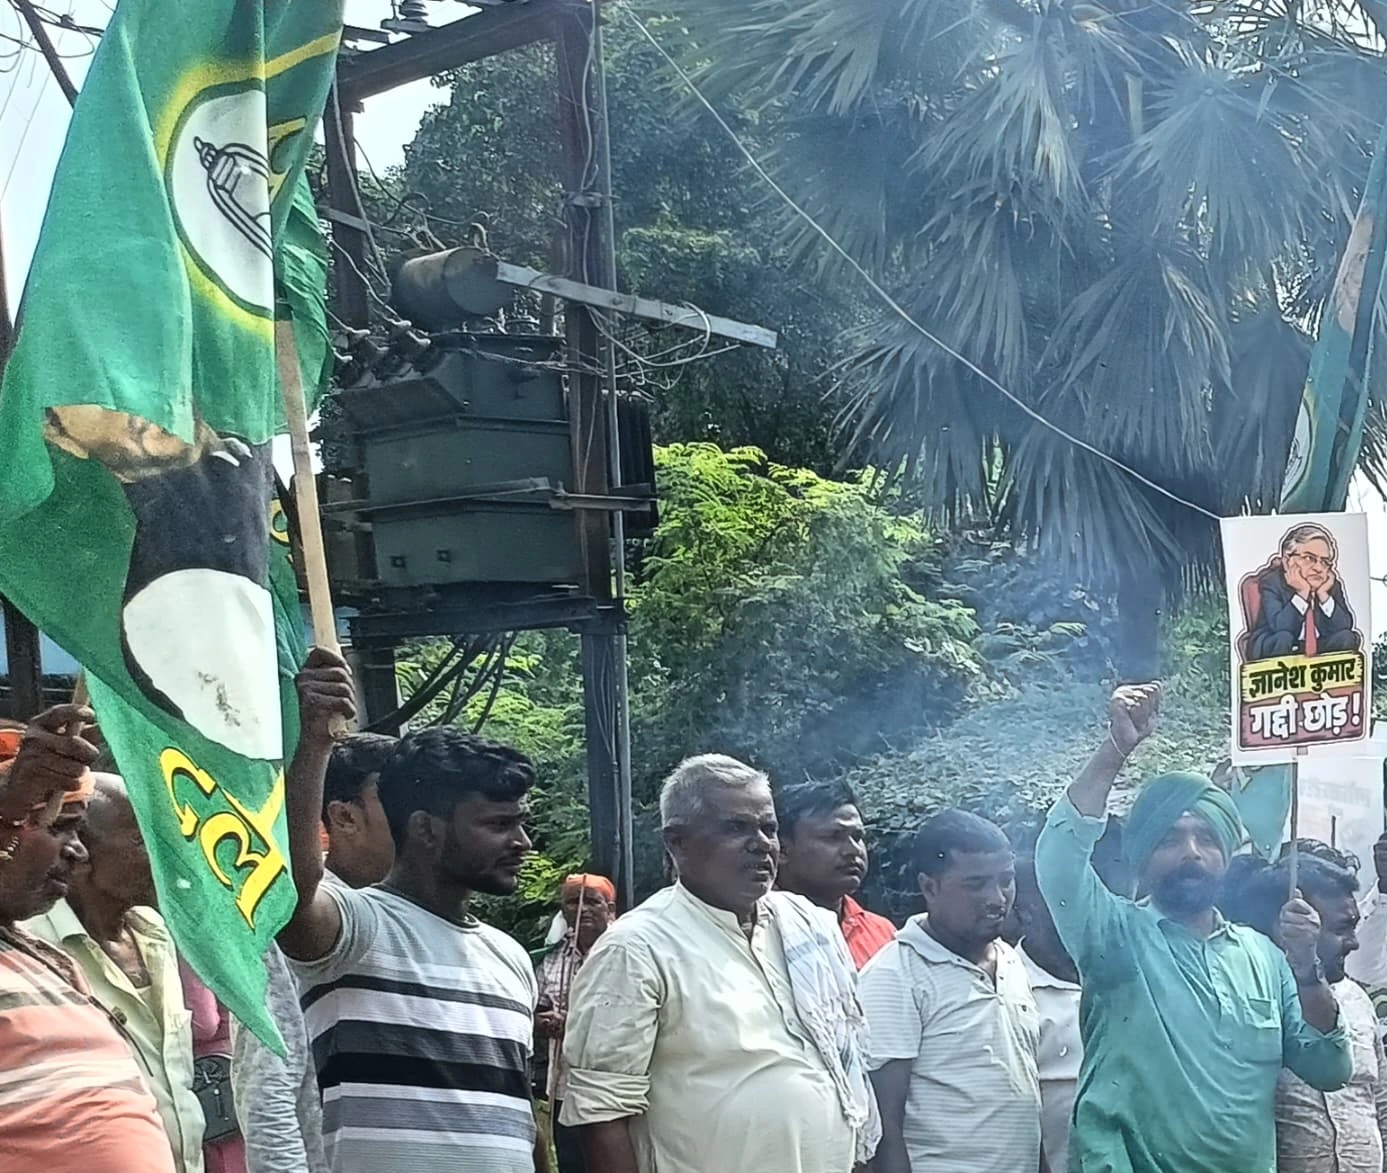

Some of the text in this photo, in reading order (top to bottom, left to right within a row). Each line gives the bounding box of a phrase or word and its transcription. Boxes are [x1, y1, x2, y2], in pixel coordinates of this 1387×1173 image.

[1248, 658, 1357, 699] ज्ञानेश कुमार
[1250, 693, 1299, 739] गद्दी
